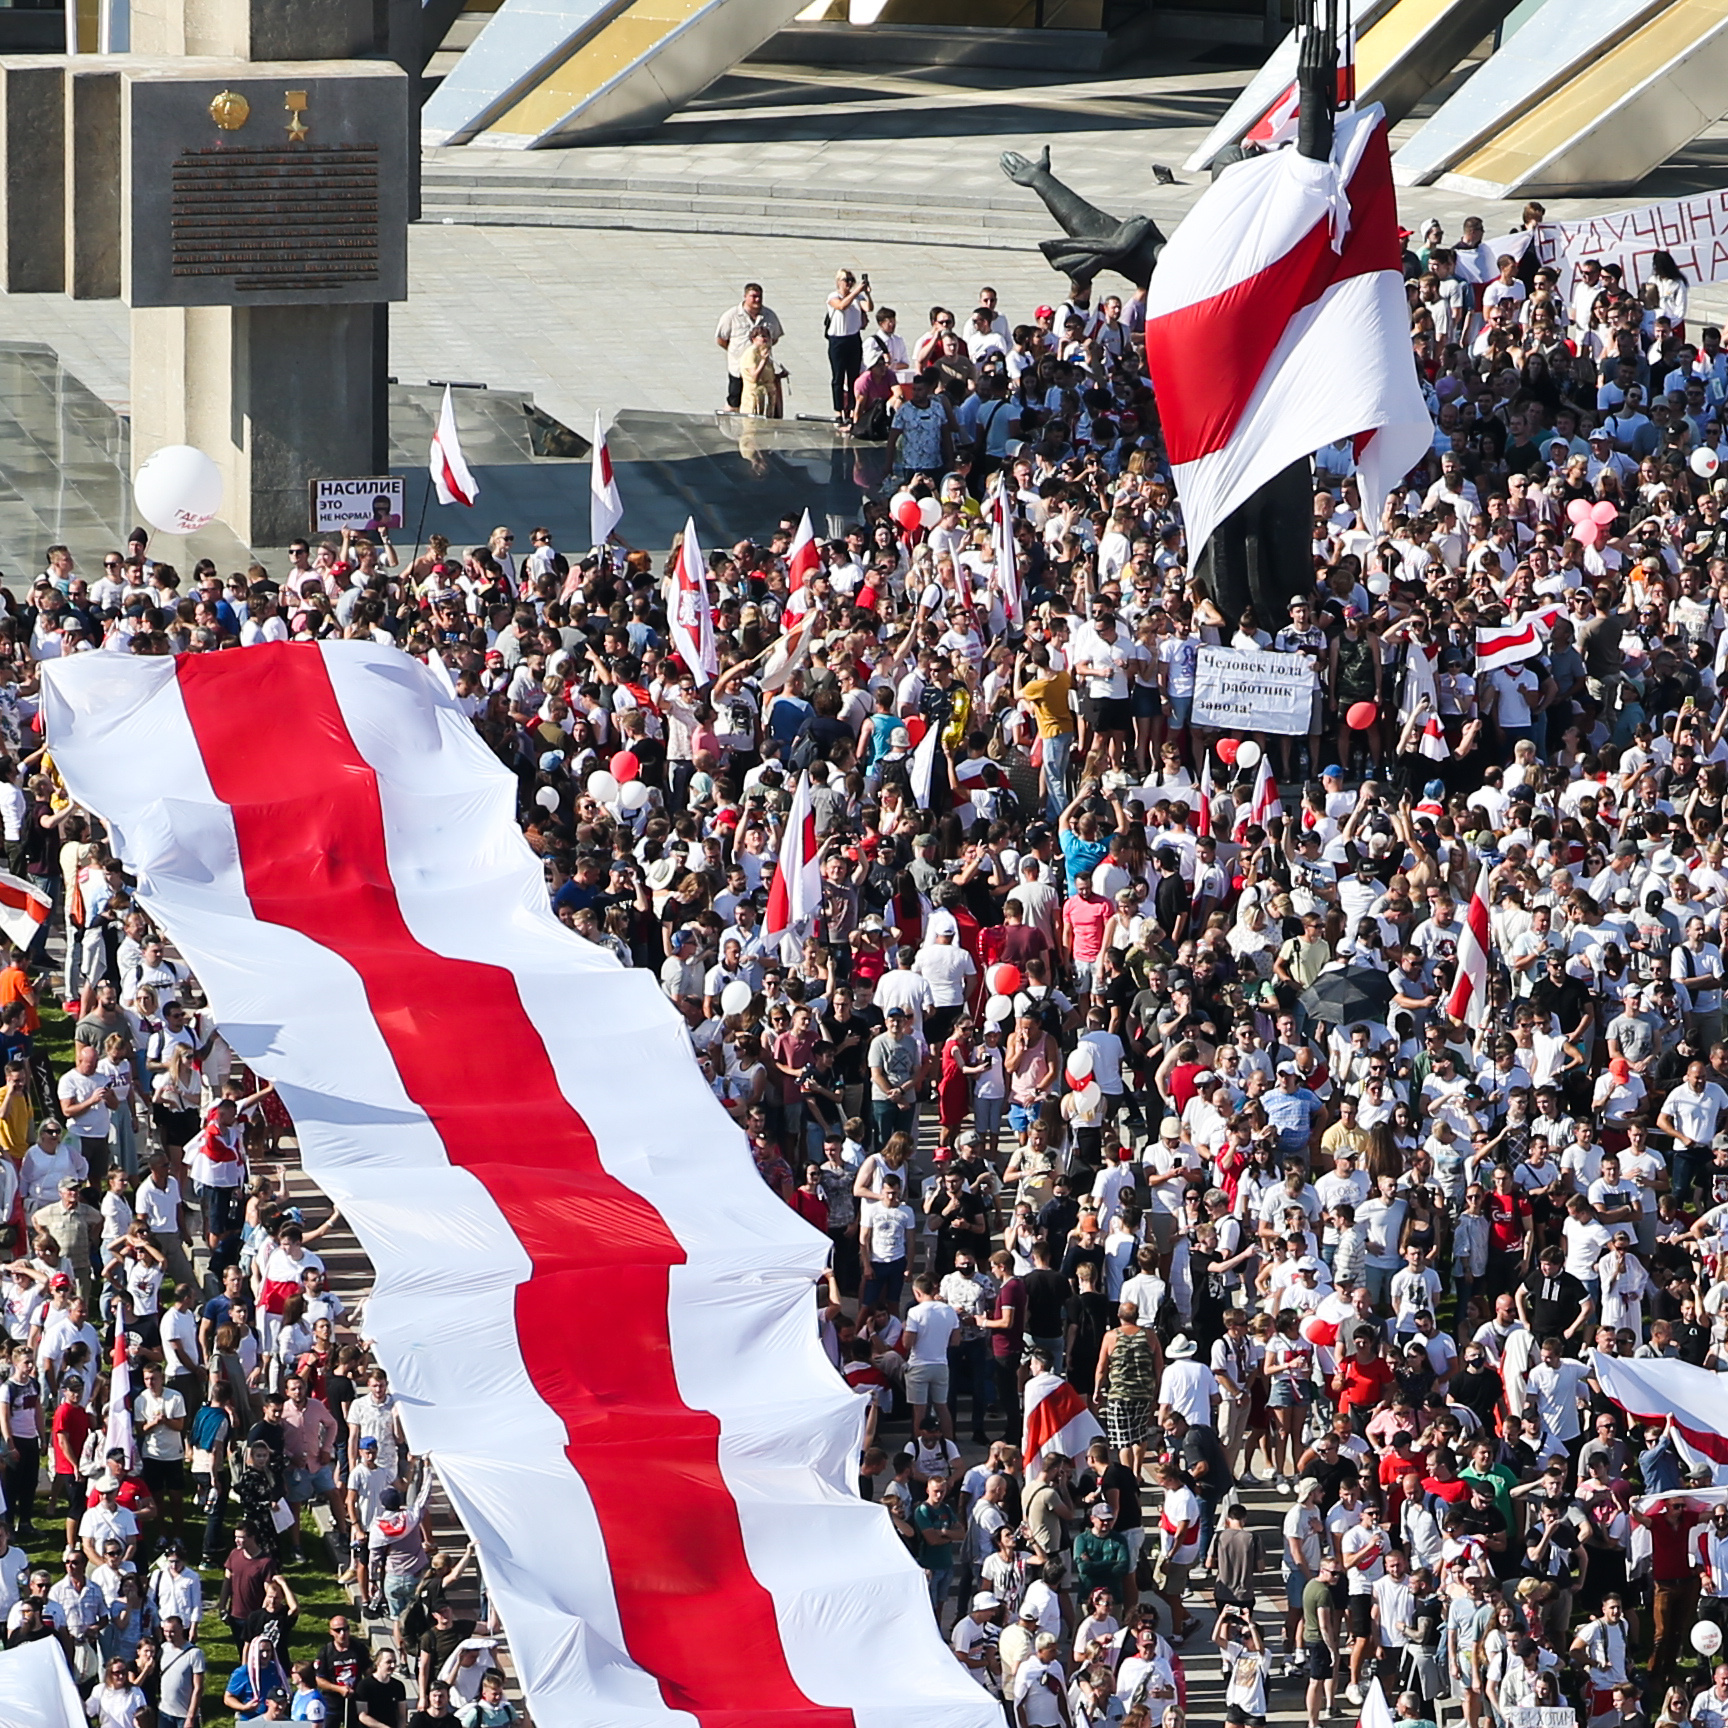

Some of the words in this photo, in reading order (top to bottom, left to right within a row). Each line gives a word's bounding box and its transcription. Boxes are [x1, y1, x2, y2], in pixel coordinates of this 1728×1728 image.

[321, 482, 401, 496] НАСИЛИЕ
[320, 500, 342, 510] ЭТО
[320, 514, 333, 522] НЕ
[334, 512, 371, 521] НОРМА!
[1204, 655, 1266, 673] Человек
[1270, 665, 1302, 677] года
[1221, 682, 1293, 697] работник
[1198, 700, 1252, 714] завода!
